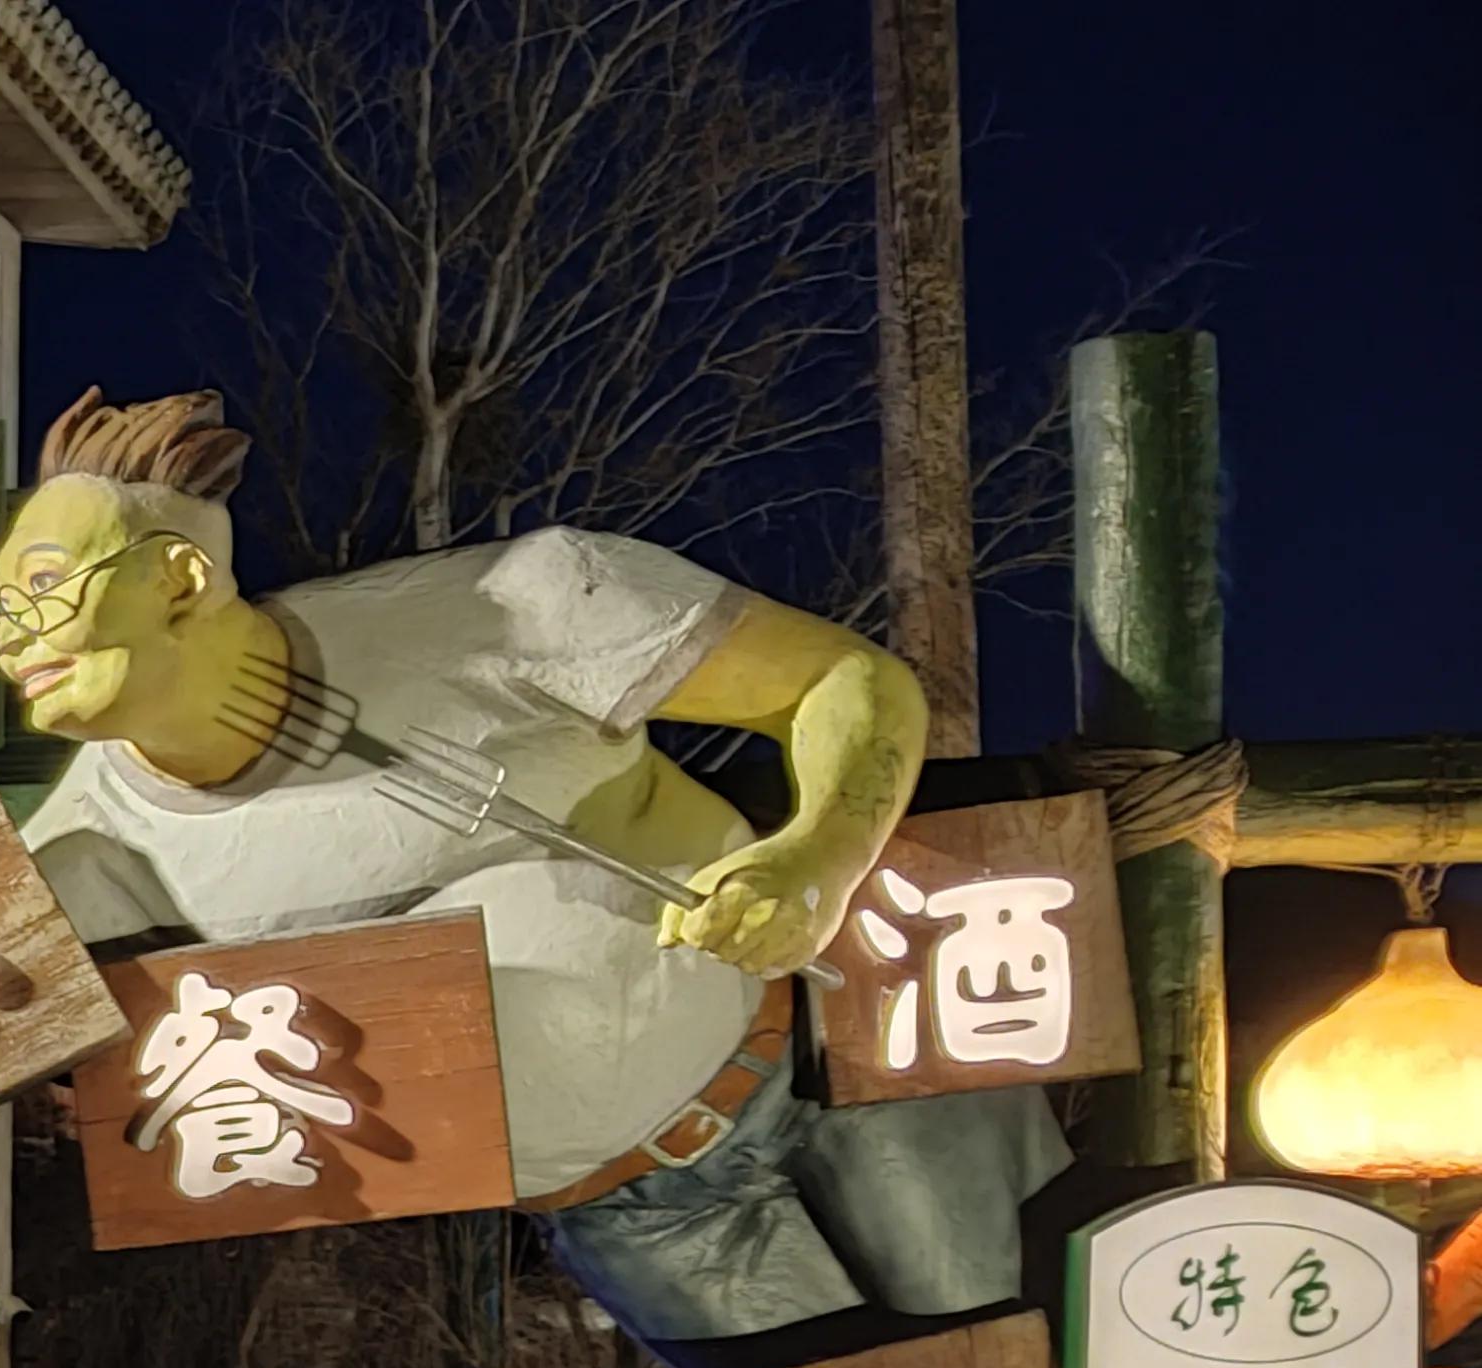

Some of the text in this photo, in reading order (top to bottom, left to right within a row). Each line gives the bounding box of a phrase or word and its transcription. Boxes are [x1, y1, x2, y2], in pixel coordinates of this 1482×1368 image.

[137, 971, 353, 1196] 餐
[857, 867, 1074, 1070] 酒
[1170, 1244, 1339, 1337] 特色
